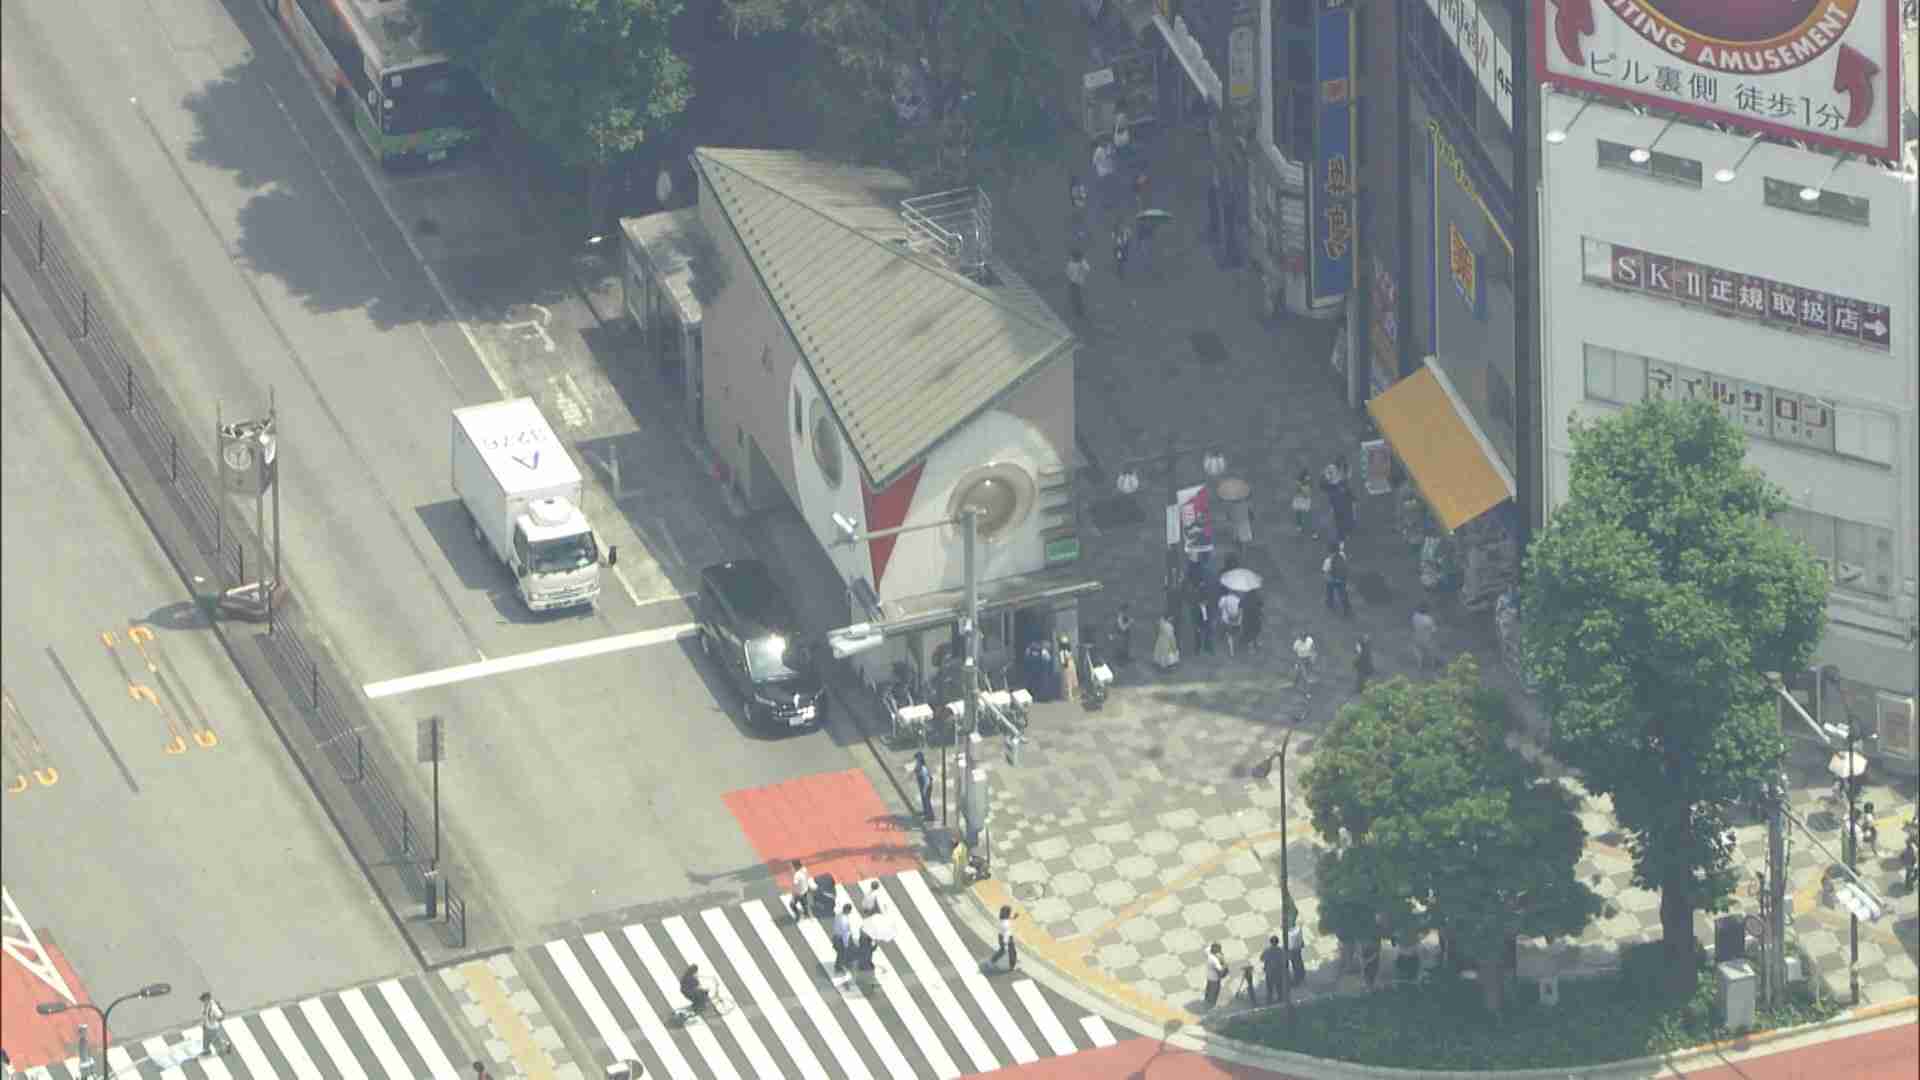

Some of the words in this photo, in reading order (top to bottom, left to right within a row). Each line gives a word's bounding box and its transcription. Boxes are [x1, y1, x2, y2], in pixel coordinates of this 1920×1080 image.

[1697, 2, 1850, 71] AMUSEMENT
[1588, 49, 1718, 103] ビル裏側
[1734, 82, 1845, 131] 徒歩1分
